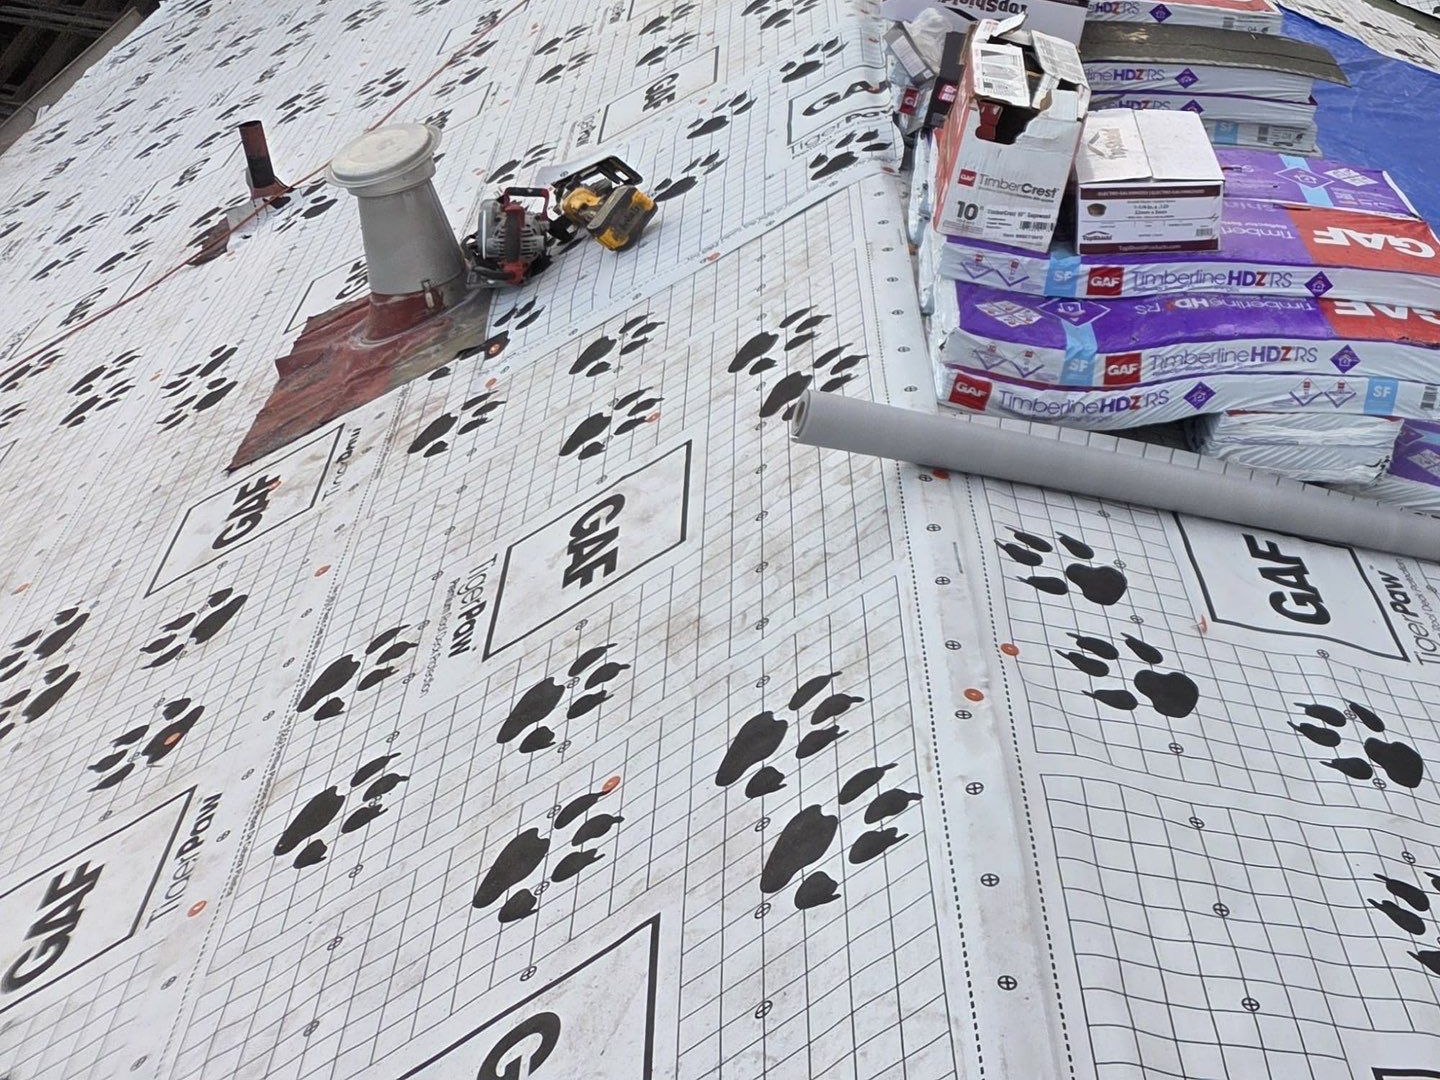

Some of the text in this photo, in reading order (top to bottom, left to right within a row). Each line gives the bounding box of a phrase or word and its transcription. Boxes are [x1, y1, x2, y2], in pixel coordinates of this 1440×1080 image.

[979, 173, 1060, 199] TimberCrest
[1313, 226, 1436, 258] GAF
[1090, 276, 1121, 288] GAF
[955, 381, 988, 399] GAF
[1107, 363, 1138, 376] GAF
[1373, 385, 1391, 398] SF
[212, 475, 281, 550] GAF
[562, 492, 625, 590] GAF
[448, 553, 498, 658] TigerPaw
[1244, 533, 1331, 625] GAF
[147, 792, 223, 928] TigerPaw
[1, 861, 104, 994] GAF
